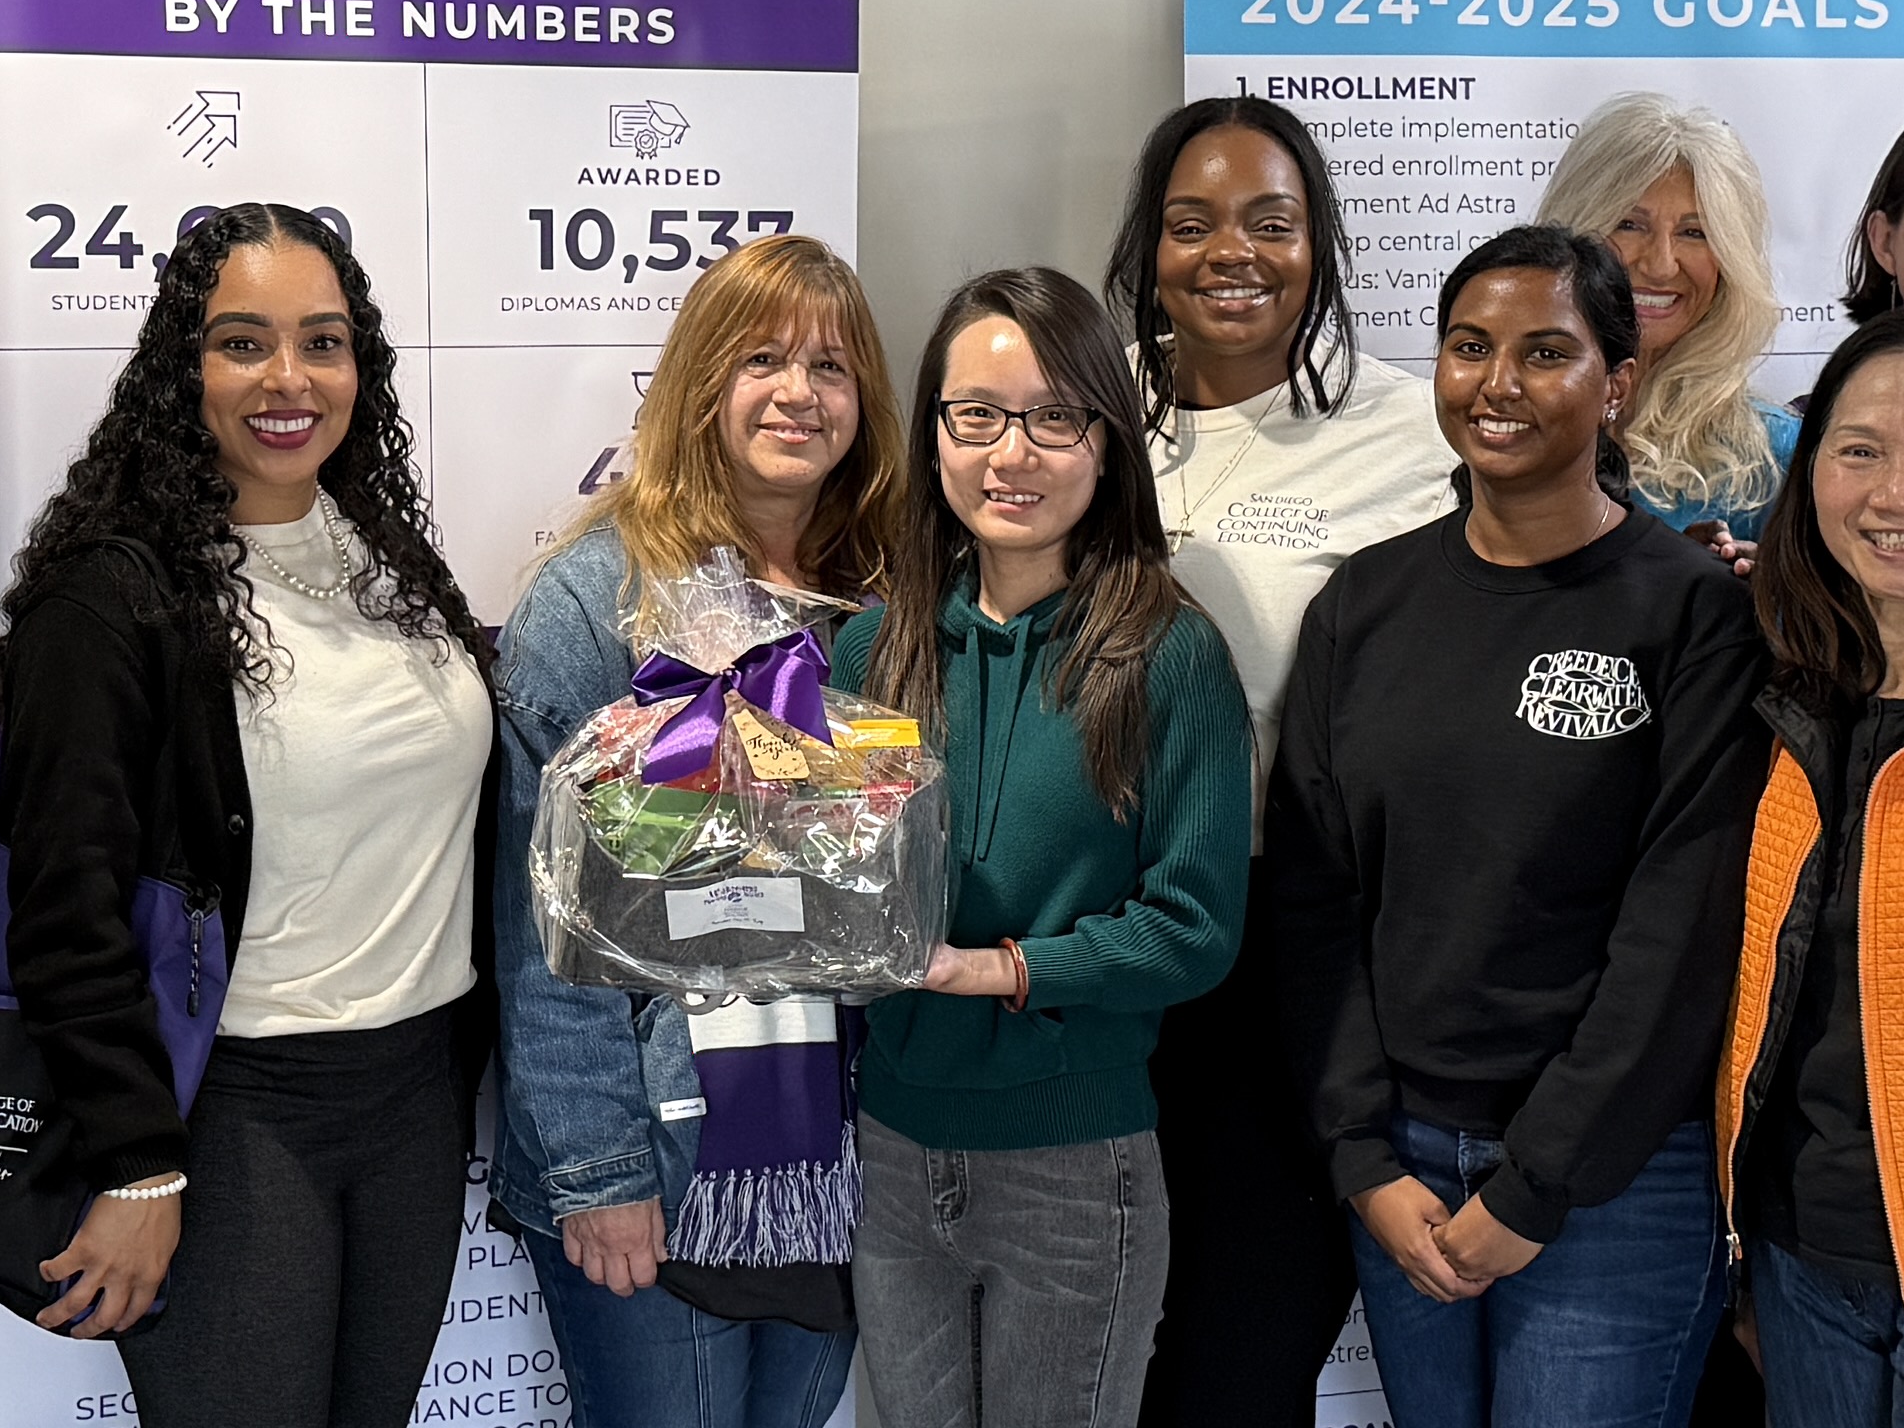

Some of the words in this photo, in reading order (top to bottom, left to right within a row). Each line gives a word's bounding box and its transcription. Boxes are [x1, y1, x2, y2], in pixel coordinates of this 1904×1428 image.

[404, 3, 675, 45] NUMBERS
[1268, 76, 1475, 100] ENROLLMENT
[1393, 155, 1523, 177] enrollment
[578, 167, 720, 186] AWARDED
[1419, 193, 1448, 214] Ad
[1456, 193, 1515, 214] Astra
[1378, 230, 1461, 251] central
[501, 297, 600, 311] DIPLOMAS
[607, 297, 650, 311] AND
[1250, 493, 1273, 503] SAN
[1228, 502, 1302, 518] COLLEGE
[1305, 508, 1329, 521] OF
[1217, 518, 1328, 540] CONTINUING
[1218, 531, 1319, 549] EDUCATION
[17, 1099, 35, 1112] OF
